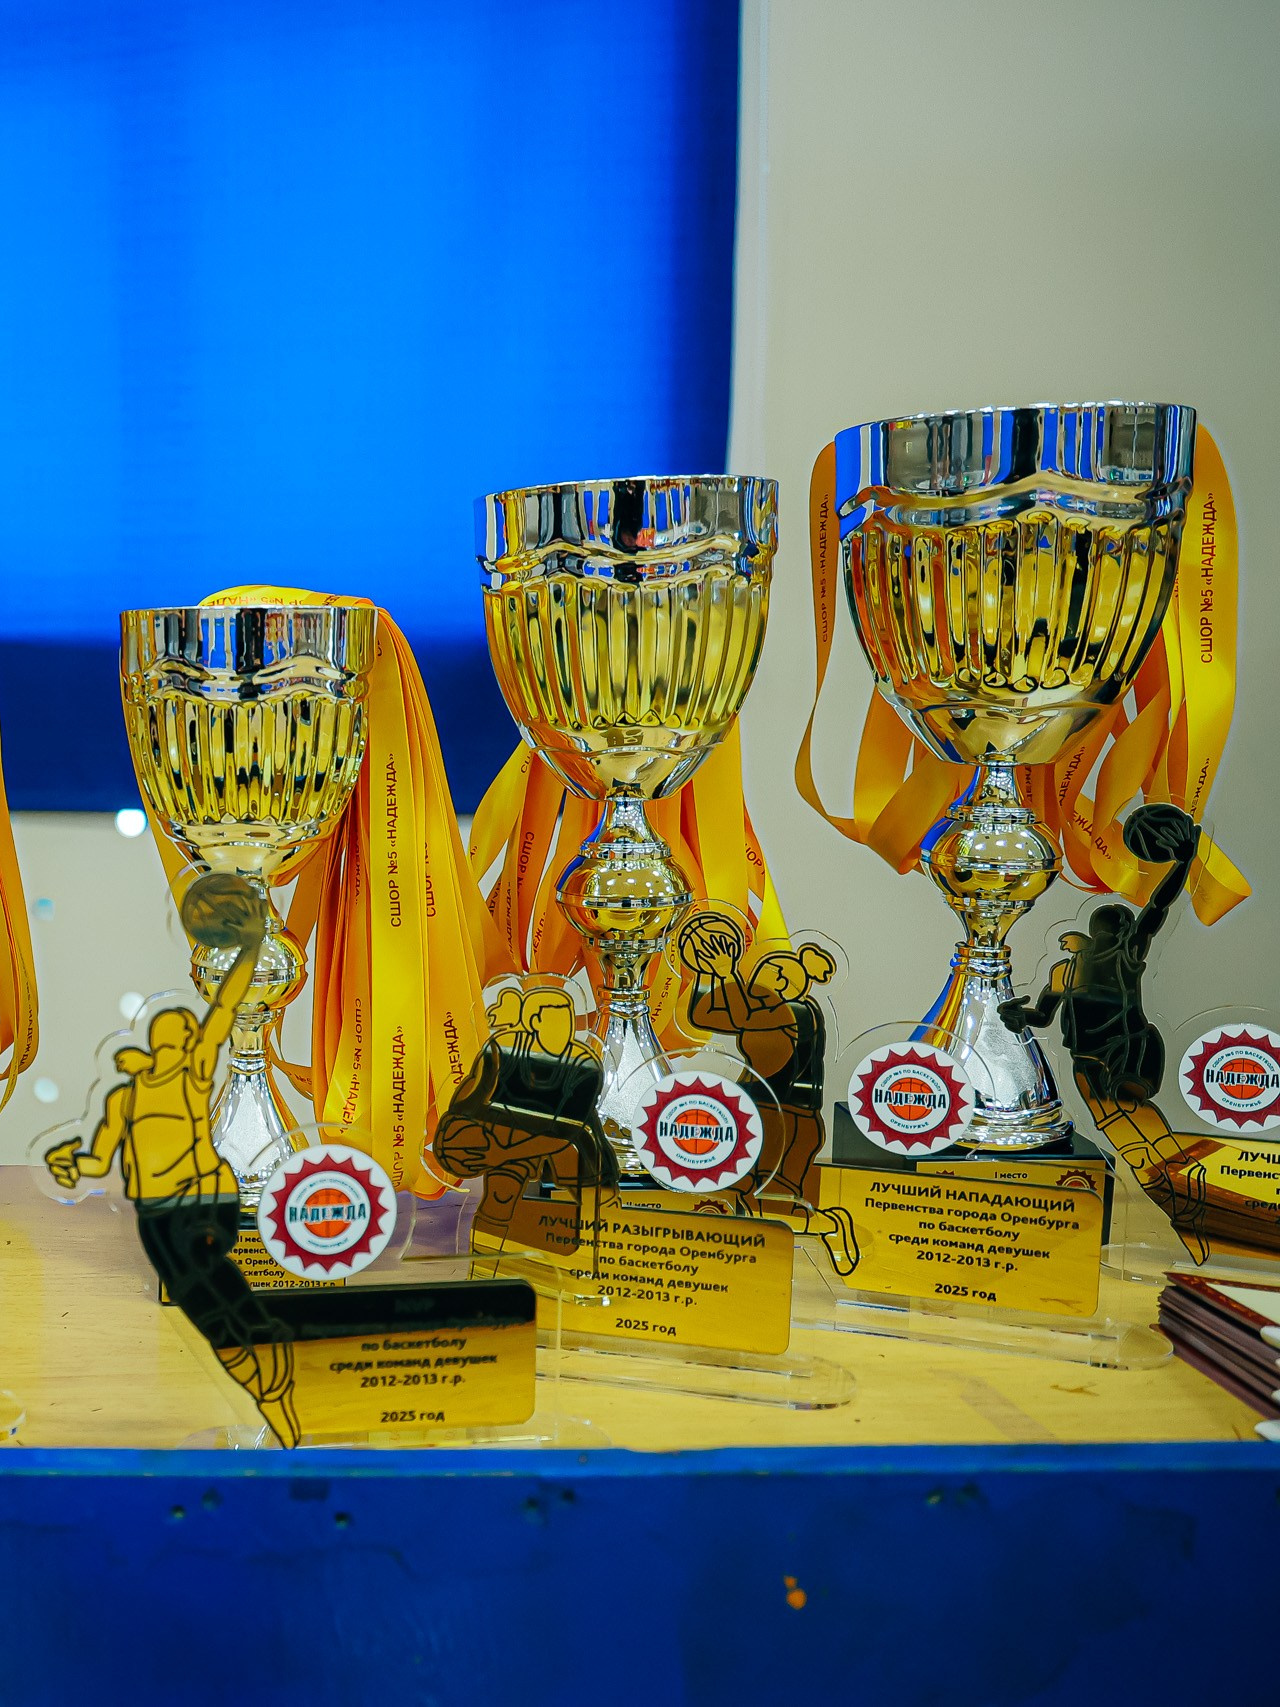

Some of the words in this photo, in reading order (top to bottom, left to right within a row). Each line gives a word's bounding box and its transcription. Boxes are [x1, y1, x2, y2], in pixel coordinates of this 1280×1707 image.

[819, 494, 829, 574] «НАДЕЖДА»
[1201, 492, 1215, 585] «НАДЕЖДА»
[820, 578, 827, 598] №5
[1200, 589, 1213, 613] №5
[1201, 618, 1213, 663] СШОР
[386, 752, 402, 848] «НАДЕЖДА»
[389, 849, 401, 873] №5
[521, 831, 535, 875] СШОР
[391, 878, 402, 927] СШОР
[355, 998, 363, 1044] СШОР
[353, 1047, 362, 1071] №5
[445, 1011, 465, 1085] АДЕЖДА»
[392, 1025, 405, 1122] «НАДЕЖДА»
[1206, 1069, 1280, 1089] НАДЕЖДА
[874, 1088, 946, 1109] НАДЕЖДА
[393, 1125, 405, 1148] №5
[659, 1121, 734, 1142] НАДЕЖДА
[391, 1152, 404, 1188] СШОР
[1220, 1165, 1280, 1179] Первенс
[870, 1181, 942, 1200] ЛУЧШИЙ
[945, 1190, 1075, 1213] НАПАДАЮЩИЙ
[865, 1197, 944, 1215] Первенства
[947, 1207, 997, 1222] города
[1001, 1211, 1080, 1231] Оренбурга
[538, 1215, 609, 1233] ЛУЧШИЙ
[613, 1223, 766, 1248] РАЗЫГРЫВАЮЩИЙ
[918, 1220, 936, 1230] по
[938, 1220, 1020, 1241] баскетболу
[545, 1232, 624, 1251] Первенства
[627, 1243, 676, 1257] города
[679, 1246, 757, 1265] Оренбурга
[888, 1232, 929, 1246] среди
[932, 1237, 984, 1254] команд
[987, 1244, 1051, 1259] девушек
[599, 1255, 616, 1265] по
[618, 1255, 699, 1277] баскетболу
[916, 1249, 991, 1269] 2012-2013
[994, 1259, 1019, 1273] г.р.
[243, 1269, 285, 1278] скетболу
[569, 1267, 610, 1282] среди
[613, 1272, 664, 1288] команд
[667, 1278, 729, 1294] девушек
[597, 1284, 671, 1303] 2012-2013
[674, 1292, 698, 1308] г.р.
[934, 1282, 969, 1297] 2025
[971, 1288, 997, 1303] год
[615, 1317, 649, 1331] 2025
[652, 1323, 677, 1337] год
[361, 1341, 379, 1352] по
[382, 1337, 467, 1351] баскетболу
[329, 1361, 373, 1373] среди
[377, 1358, 431, 1369] команд
[434, 1354, 498, 1368] девушек
[360, 1373, 438, 1389] 2012-2013
[441, 1375, 466, 1387] г.р.
[380, 1410, 416, 1423] 2025
[419, 1410, 445, 1422] год
